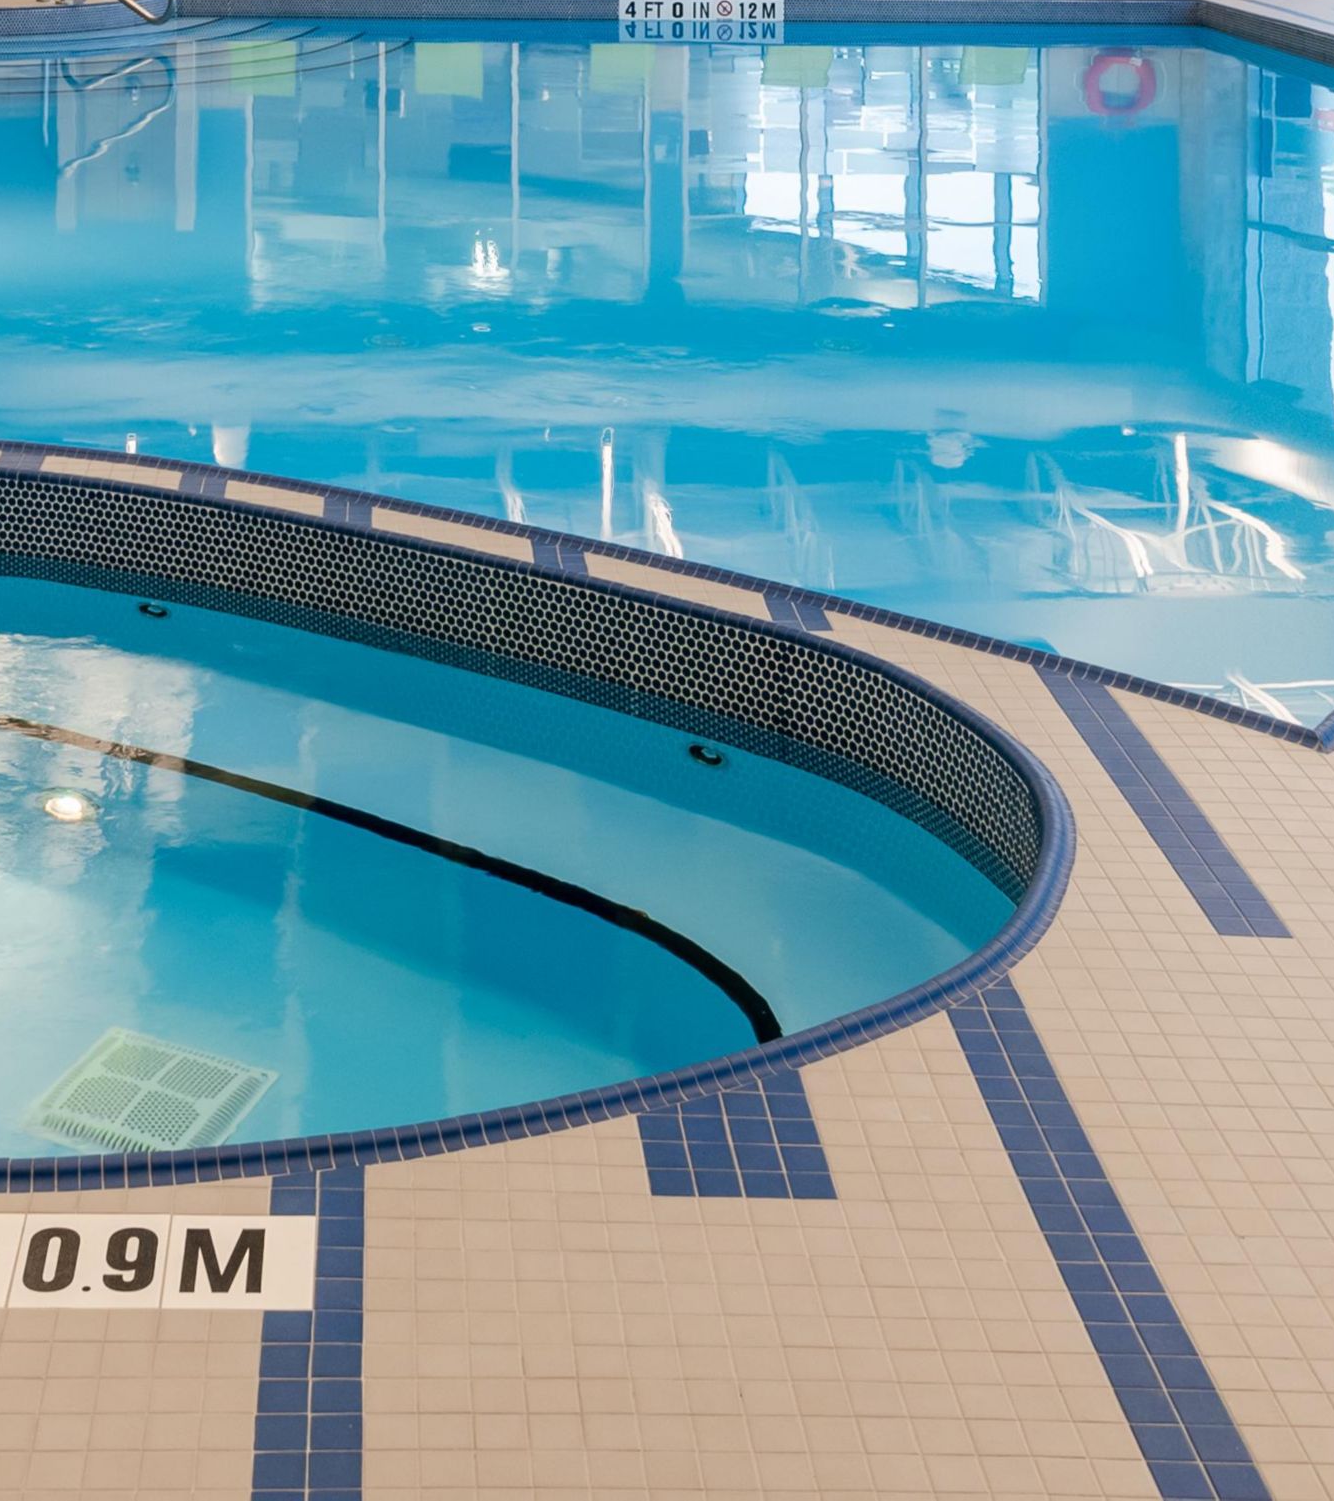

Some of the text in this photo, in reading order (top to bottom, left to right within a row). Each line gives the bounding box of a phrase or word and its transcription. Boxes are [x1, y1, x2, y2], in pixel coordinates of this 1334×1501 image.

[625, 1, 636, 18] 4
[645, 1, 664, 19] FT
[693, 1, 709, 19] IN
